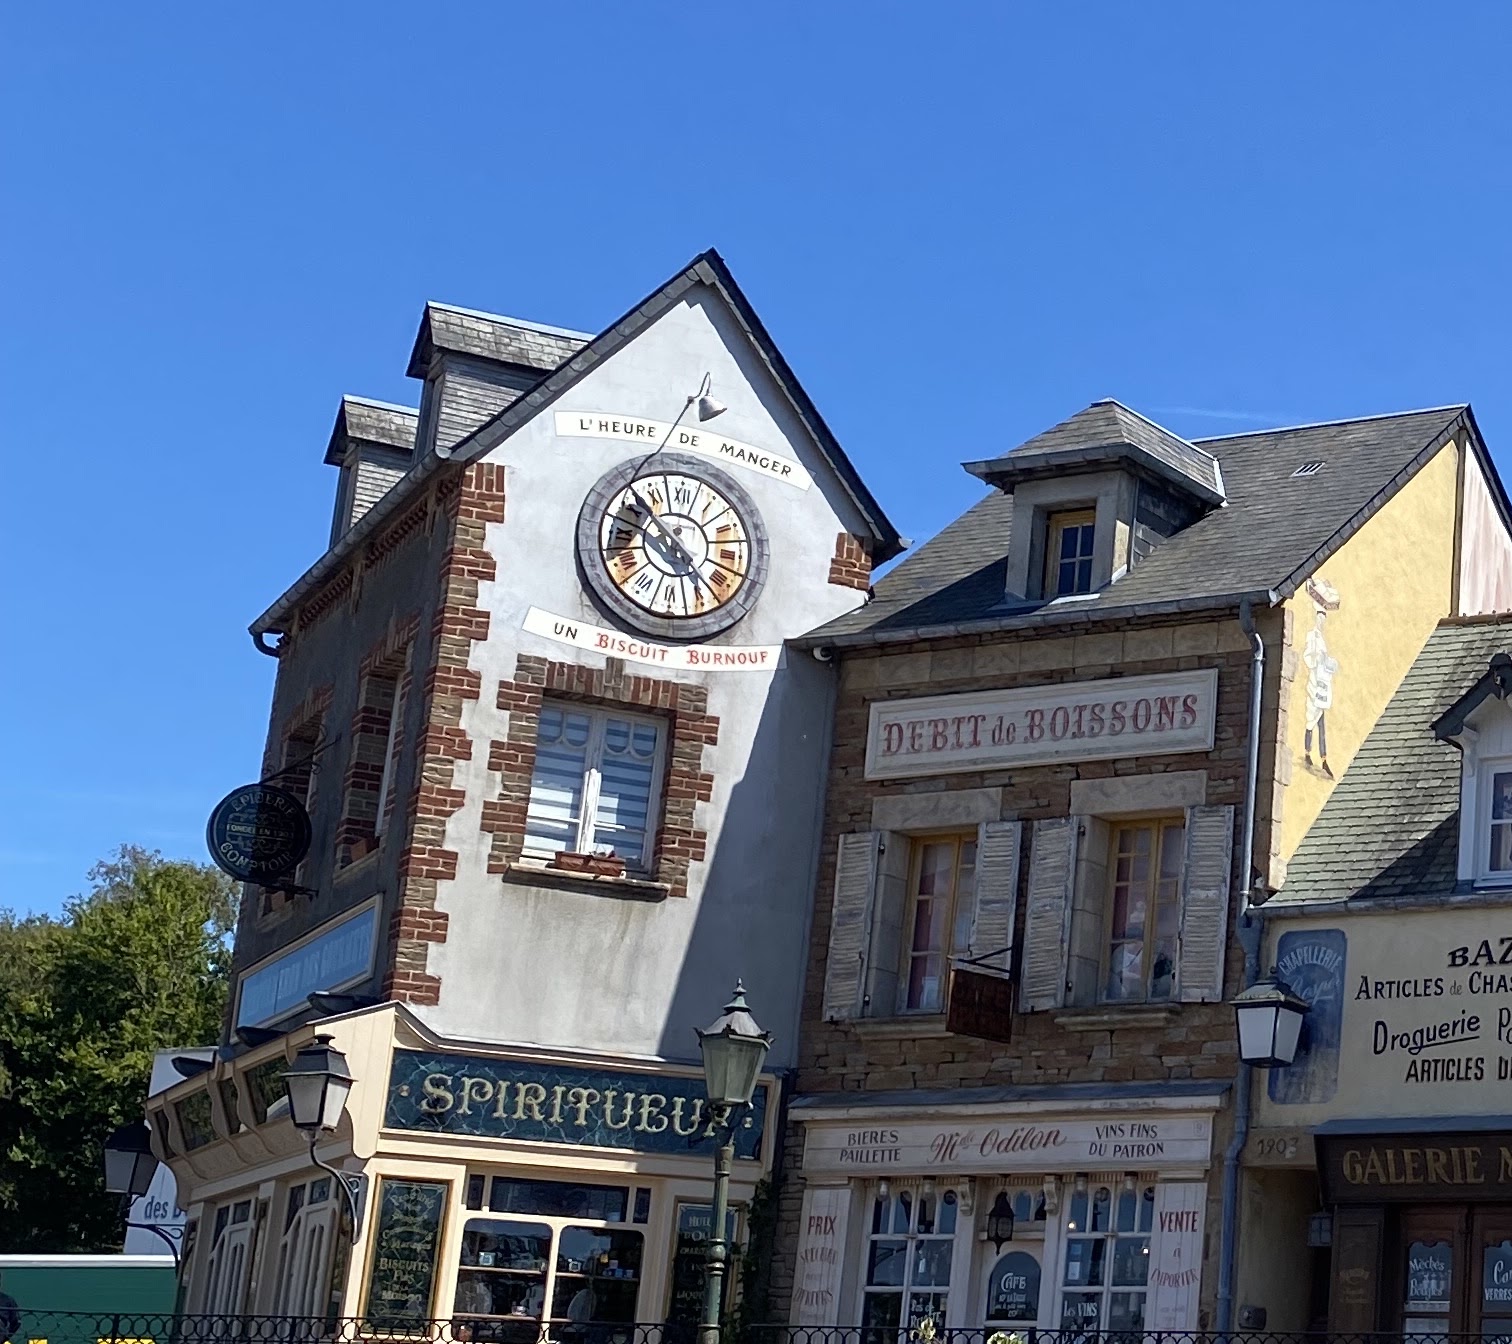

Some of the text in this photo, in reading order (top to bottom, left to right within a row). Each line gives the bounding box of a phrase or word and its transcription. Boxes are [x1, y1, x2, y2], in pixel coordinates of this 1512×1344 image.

[579, 419, 792, 477] L'HEURE DE MANGER
[554, 622, 768, 665] UN BISCUIT BURNOUF
[882, 694, 1198, 755] DEBIT de BOISSONS
[1278, 945, 1344, 975] CHAPELLERIE
[1354, 975, 1444, 1001] ARTICLES
[1450, 981, 1462, 996] de
[1373, 1010, 1480, 1056] Droguerie
[1405, 1057, 1485, 1084] ARTICLES
[840, 1142, 1164, 1164] PAILLETTE DU PATRON
[848, 1129, 899, 1147] BIERES
[979, 1126, 1067, 1157] Odilon
[1095, 1123, 1125, 1140] VINS
[1129, 1123, 1159, 1139] FINS
[1342, 1147, 1485, 1185] GALERIE
[145, 1196, 168, 1219] des
[808, 1216, 837, 1236] PRIX
[1159, 1211, 1199, 1233] VENTE
[1485, 1288, 1512, 1301] VERRES
